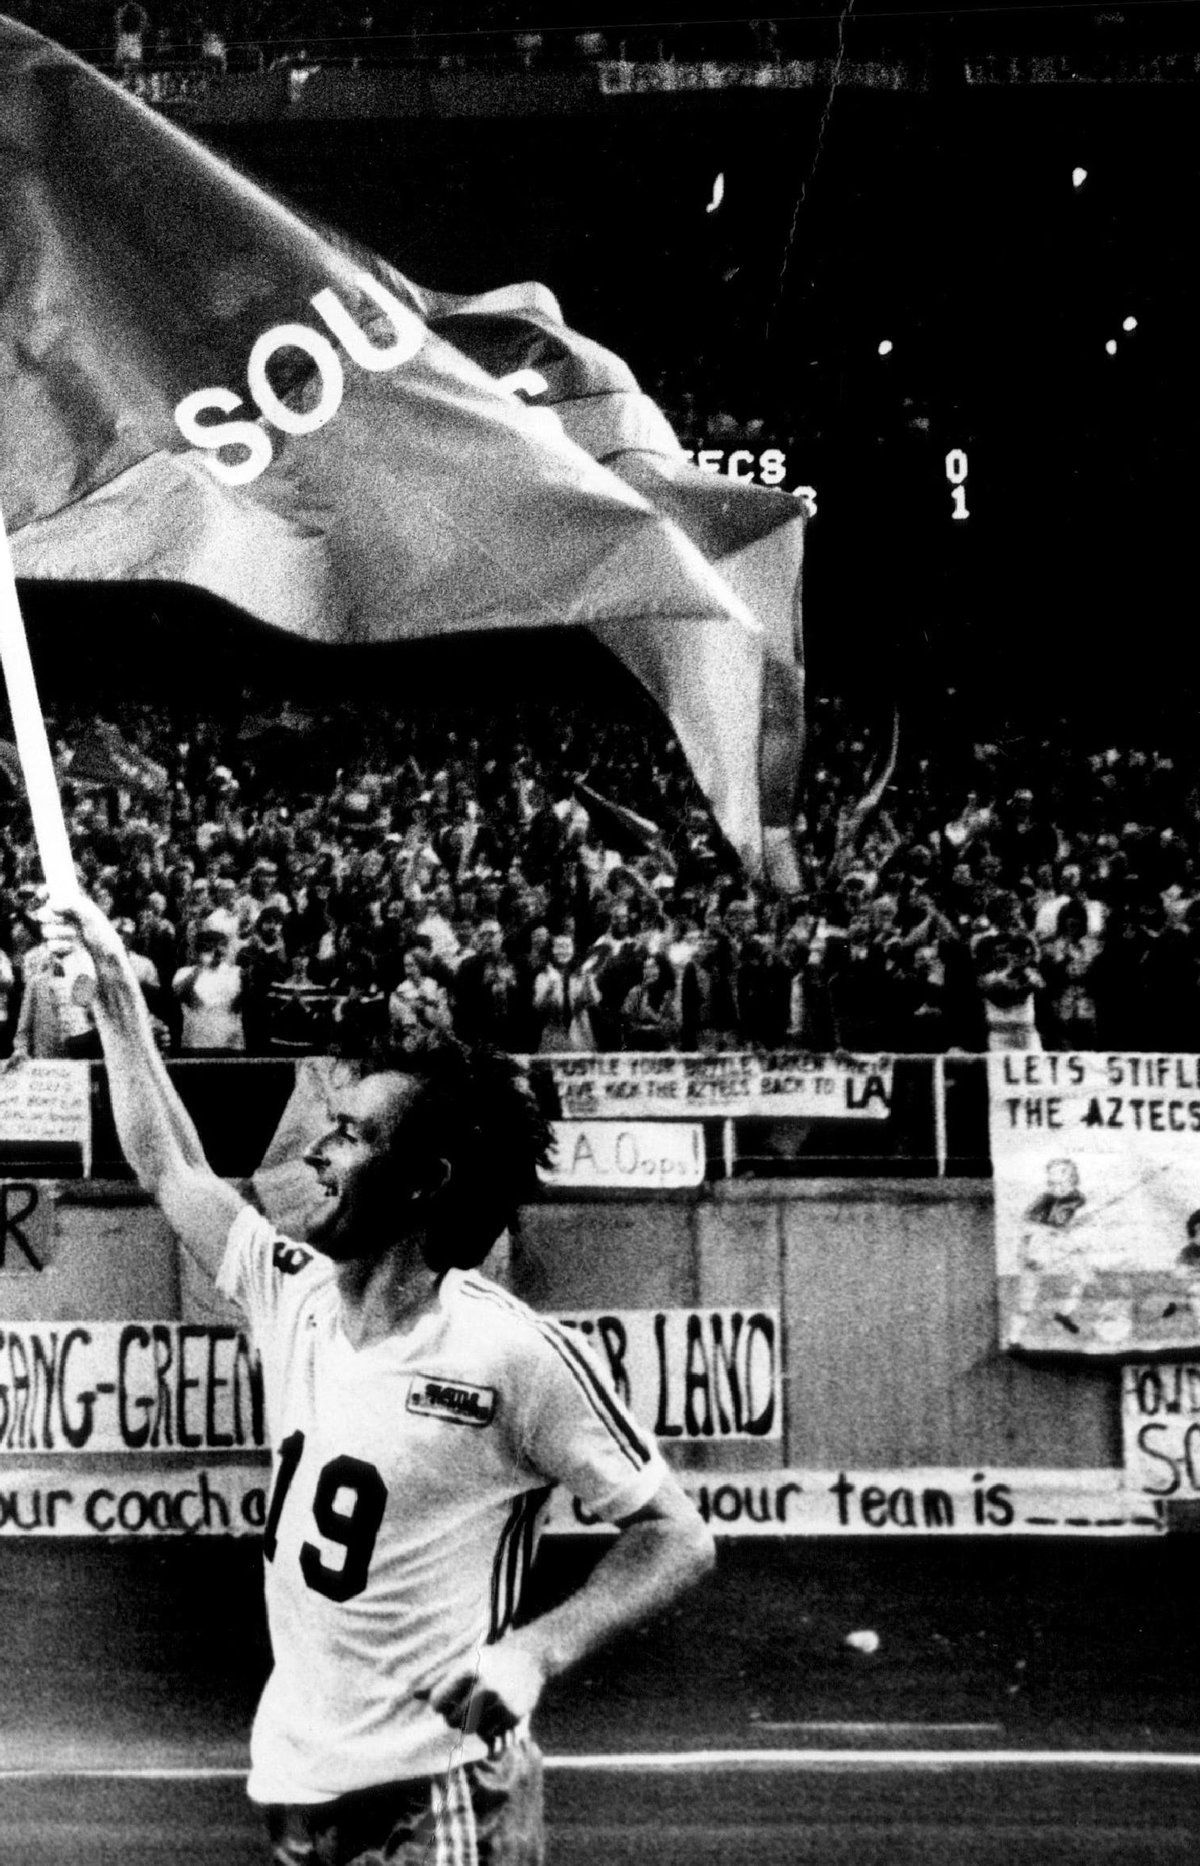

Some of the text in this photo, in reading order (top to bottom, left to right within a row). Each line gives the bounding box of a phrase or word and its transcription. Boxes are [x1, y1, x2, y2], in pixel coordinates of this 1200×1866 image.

[945, 449, 968, 484] 0
[951, 485, 970, 520] 1
[1004, 1056, 1200, 1090] LETS STIFL
[845, 1075, 890, 1109] LA
[1005, 1097, 1200, 1132] THE AZTECS
[654, 1311, 775, 1437] LAND
[85, 1471, 231, 1532] coach
[699, 1482, 803, 1524] our
[828, 1472, 956, 1528] team
